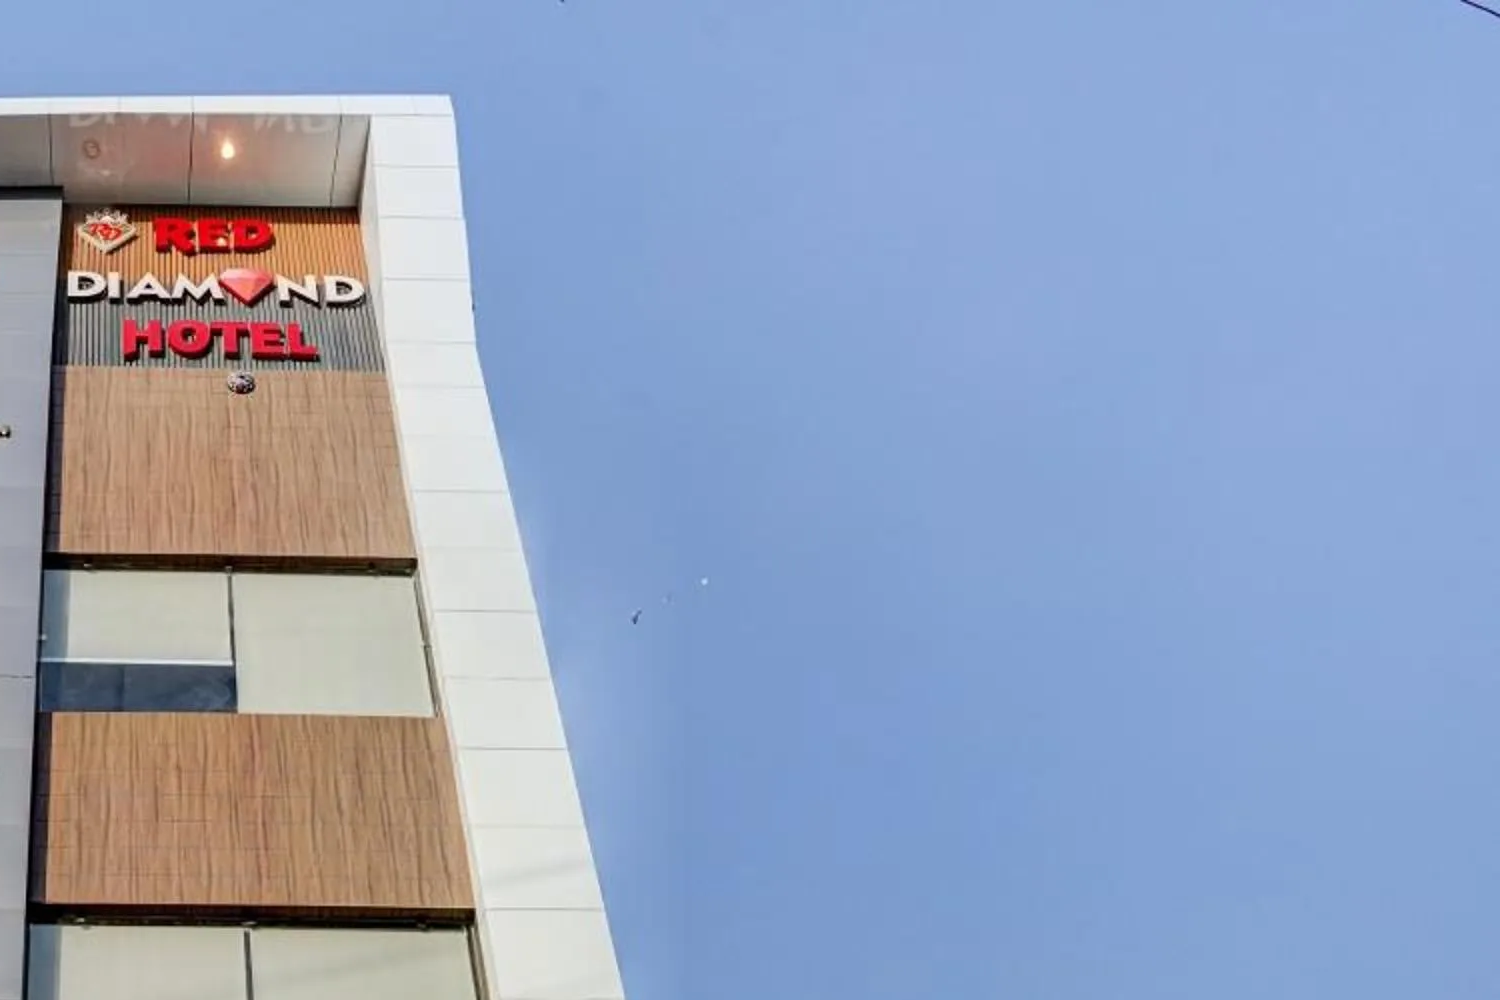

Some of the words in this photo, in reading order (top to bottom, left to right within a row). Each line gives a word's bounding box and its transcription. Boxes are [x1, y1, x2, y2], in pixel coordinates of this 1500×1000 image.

[152, 216, 277, 256] RED
[67, 268, 367, 308] DIAMND
[122, 318, 320, 362] HOTEL
